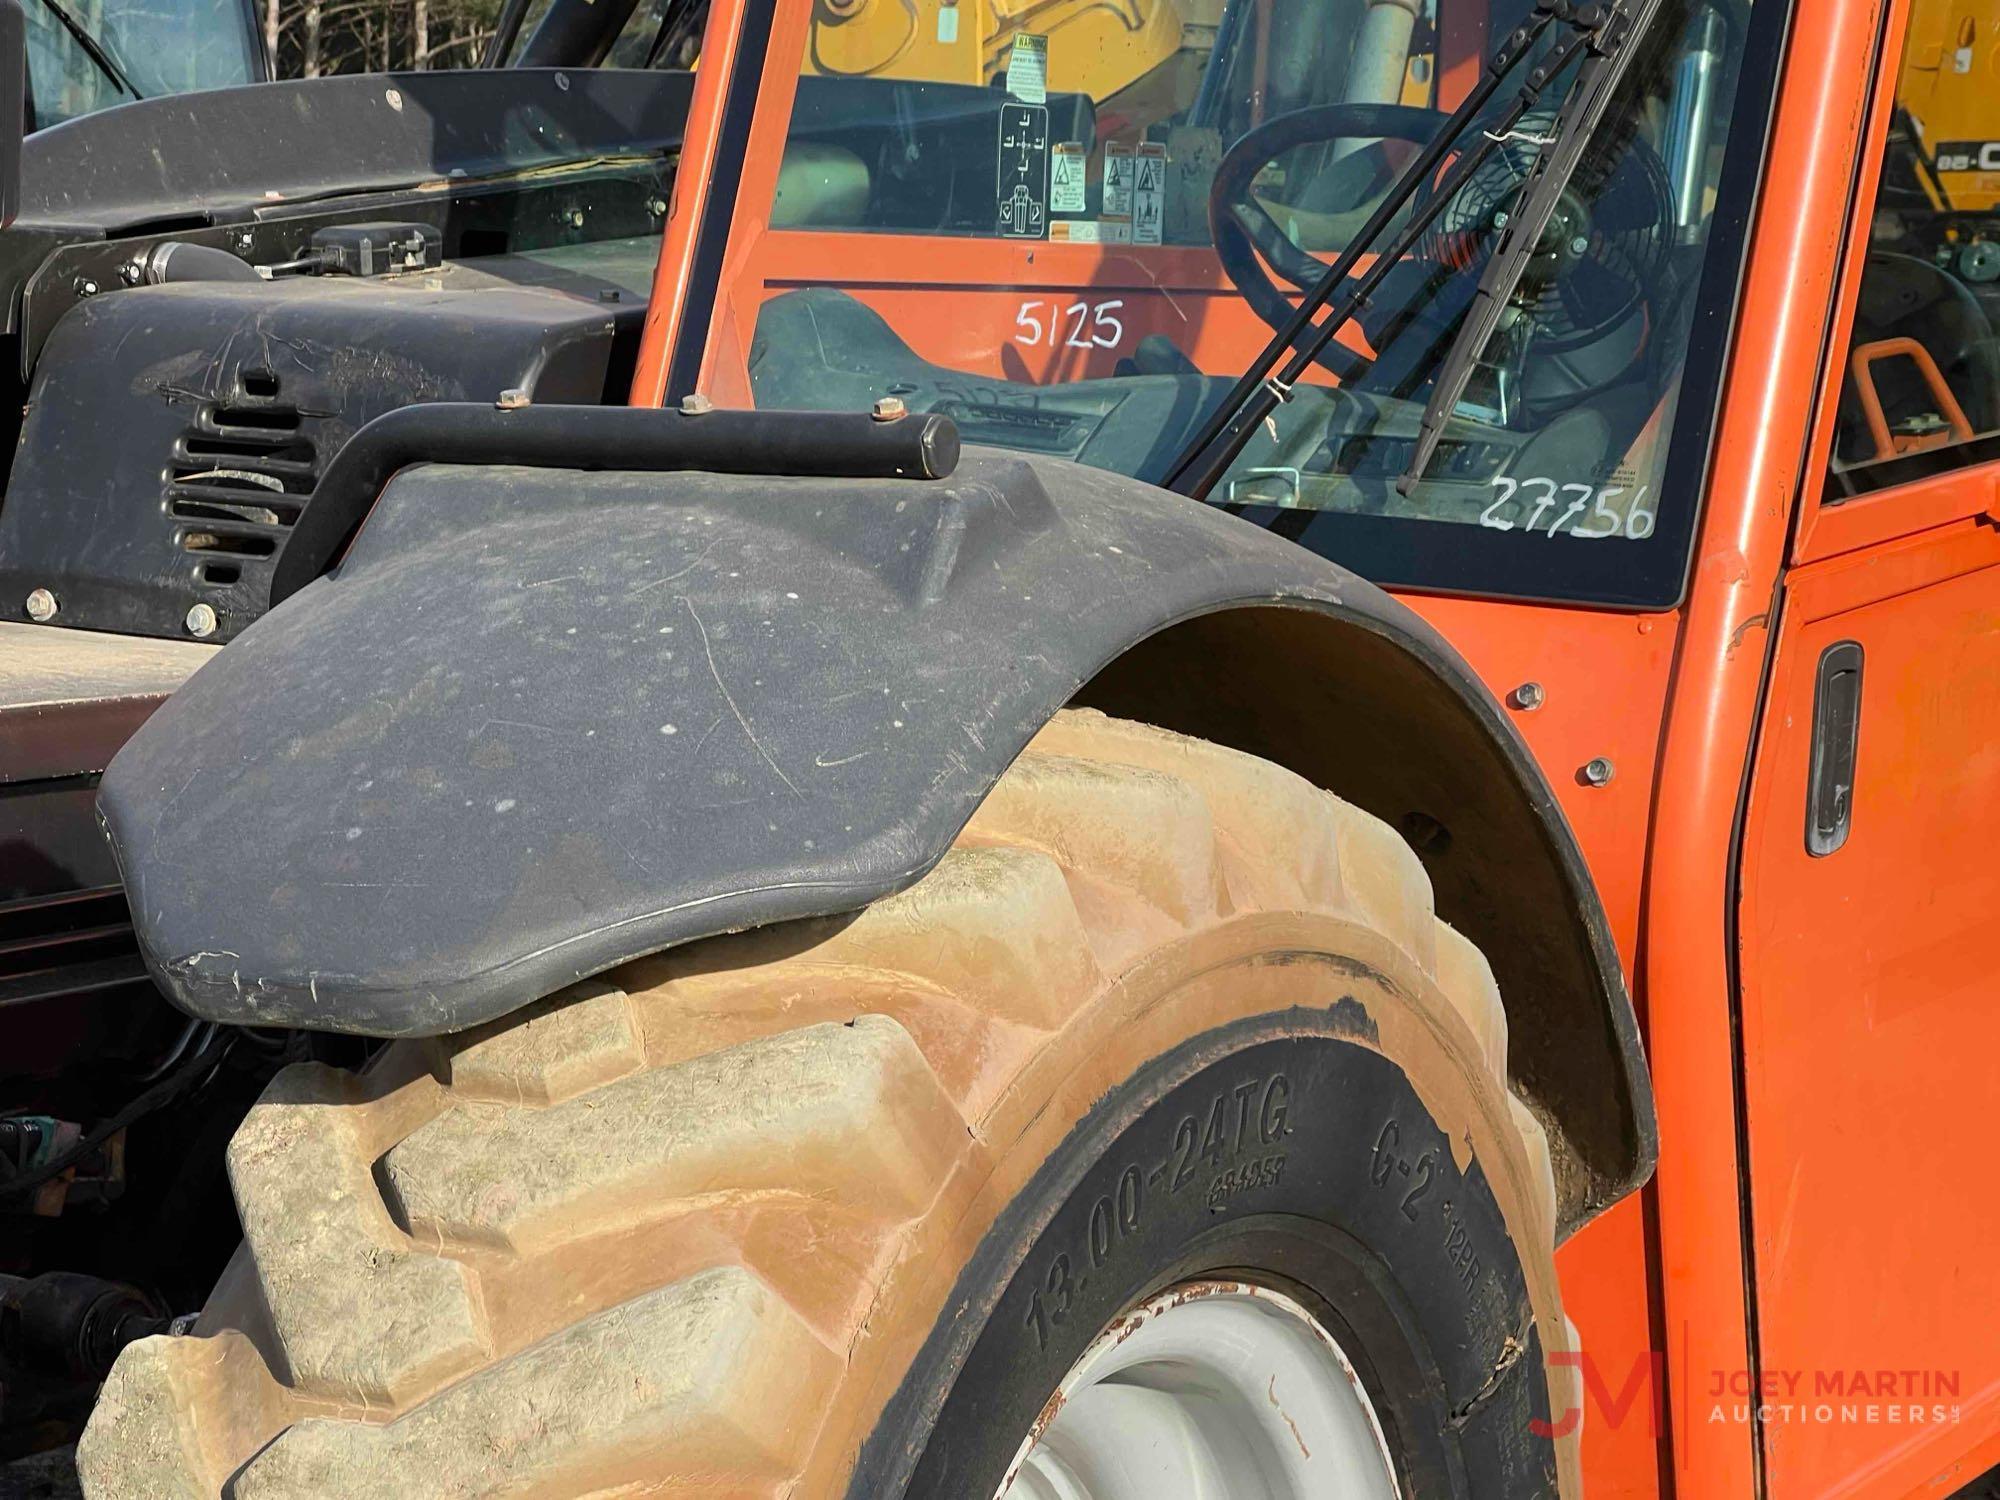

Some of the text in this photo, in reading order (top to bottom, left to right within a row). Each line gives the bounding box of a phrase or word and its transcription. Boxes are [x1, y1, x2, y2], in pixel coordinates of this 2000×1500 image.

[1014, 299, 1124, 348] 5125
[1479, 474, 1654, 540] 27756
[1371, 1118, 1436, 1223] G-2
